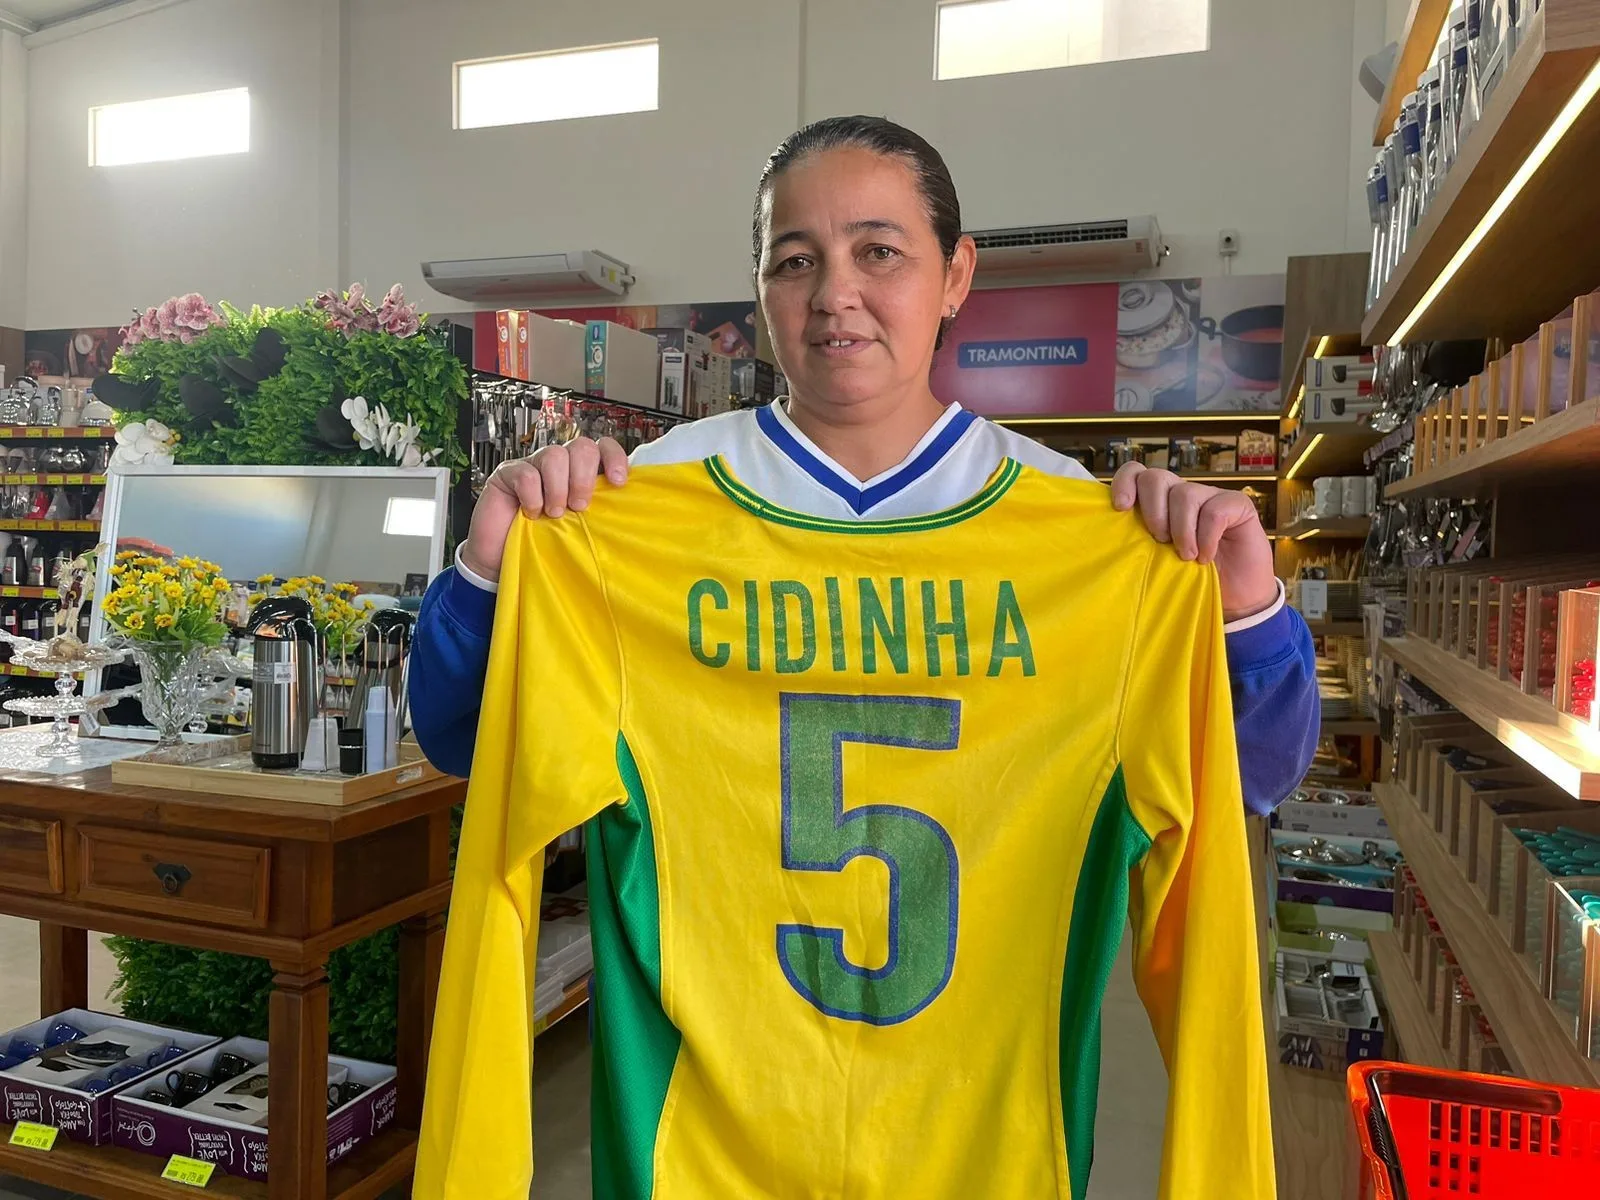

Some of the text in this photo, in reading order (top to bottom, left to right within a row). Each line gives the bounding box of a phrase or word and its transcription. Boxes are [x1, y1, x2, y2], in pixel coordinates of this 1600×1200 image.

[967, 345, 1077, 362] TRAMONTINA
[687, 576, 1036, 677] CIDINHA
[776, 692, 961, 1026] 5
[11, 1108, 30, 1119] LOVE
[197, 1149, 218, 1160] LOVE
[250, 1161, 268, 1173] MOR
